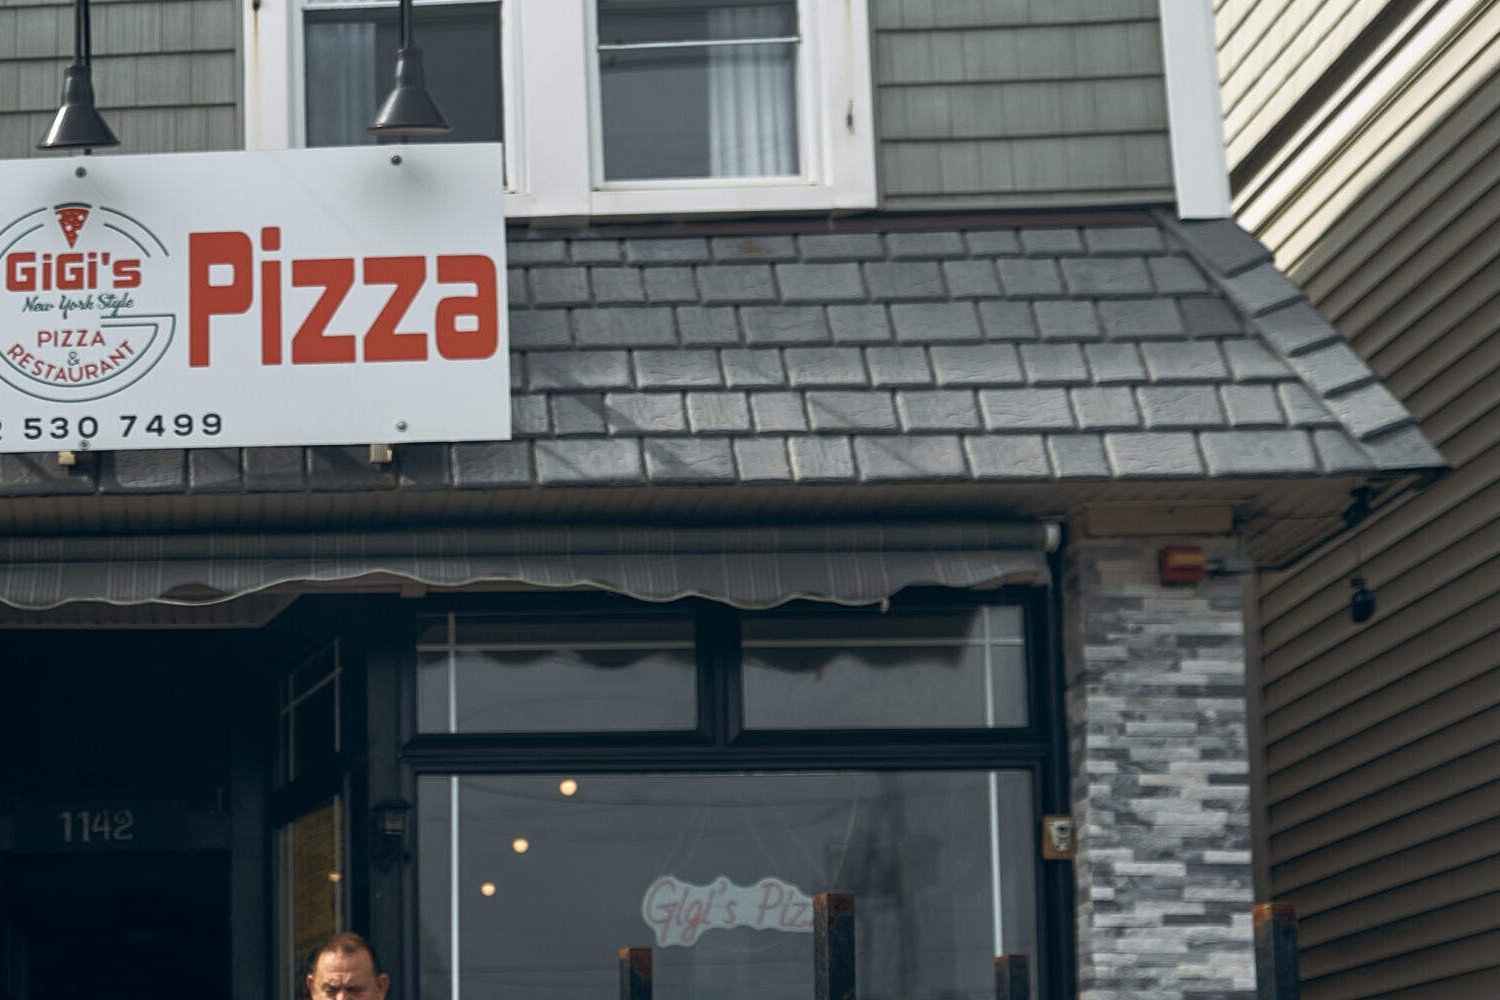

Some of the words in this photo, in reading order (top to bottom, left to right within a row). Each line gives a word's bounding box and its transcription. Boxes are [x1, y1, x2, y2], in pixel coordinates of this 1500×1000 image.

[6, 252, 141, 291] GiGi's
[22, 296, 54, 313] New
[59, 294, 95, 319] York
[98, 292, 134, 317] Style
[189, 227, 498, 367] Pizza
[37, 329, 106, 348] PIZZA
[7, 340, 135, 382] RESTAURANT
[66, 351, 80, 366] &
[24, 416, 99, 440] 530
[120, 412, 223, 438] 7499
[57, 810, 135, 843] 1142
[646, 879, 737, 944] Gigi's
[758, 881, 814, 927] Piz
